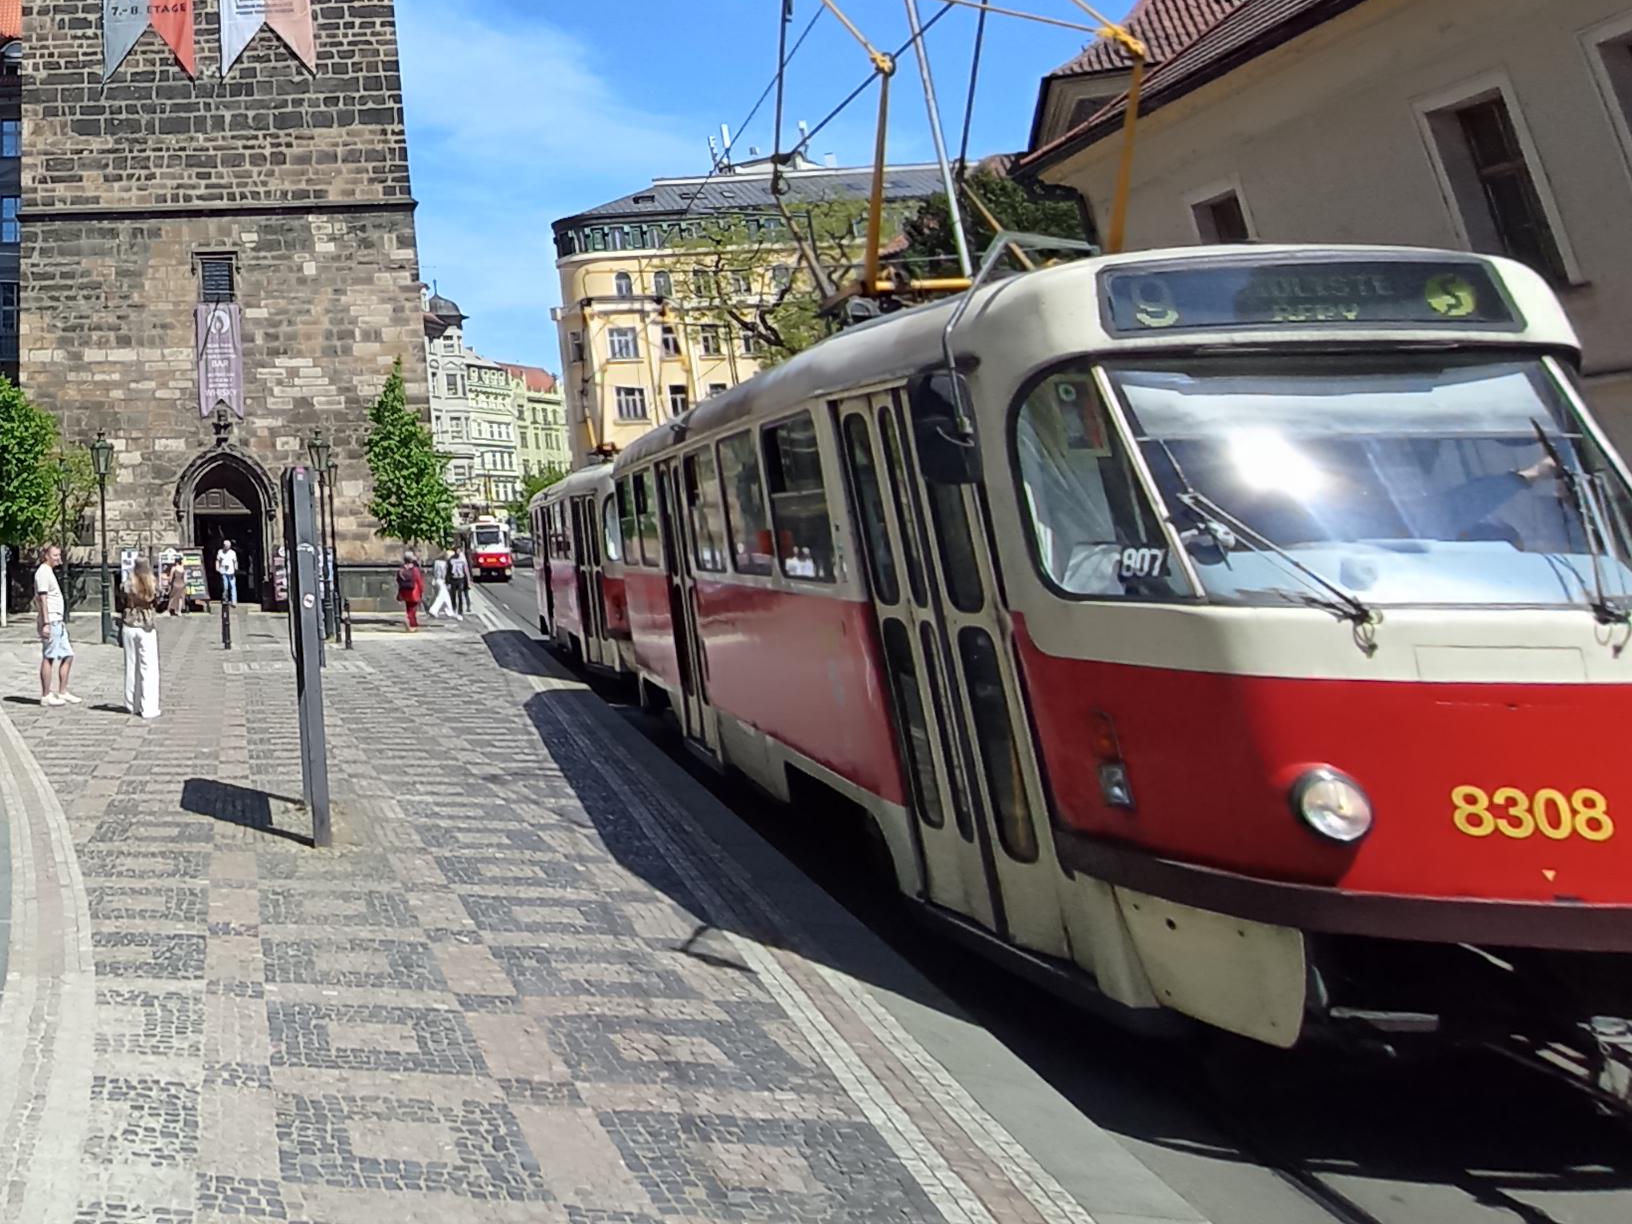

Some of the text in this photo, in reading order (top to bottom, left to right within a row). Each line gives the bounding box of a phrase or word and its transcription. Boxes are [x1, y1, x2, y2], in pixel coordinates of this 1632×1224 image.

[146, 2, 187, 15] ETAGE
[211, 359, 229, 368] BAR
[1451, 784, 1615, 842] 8308
